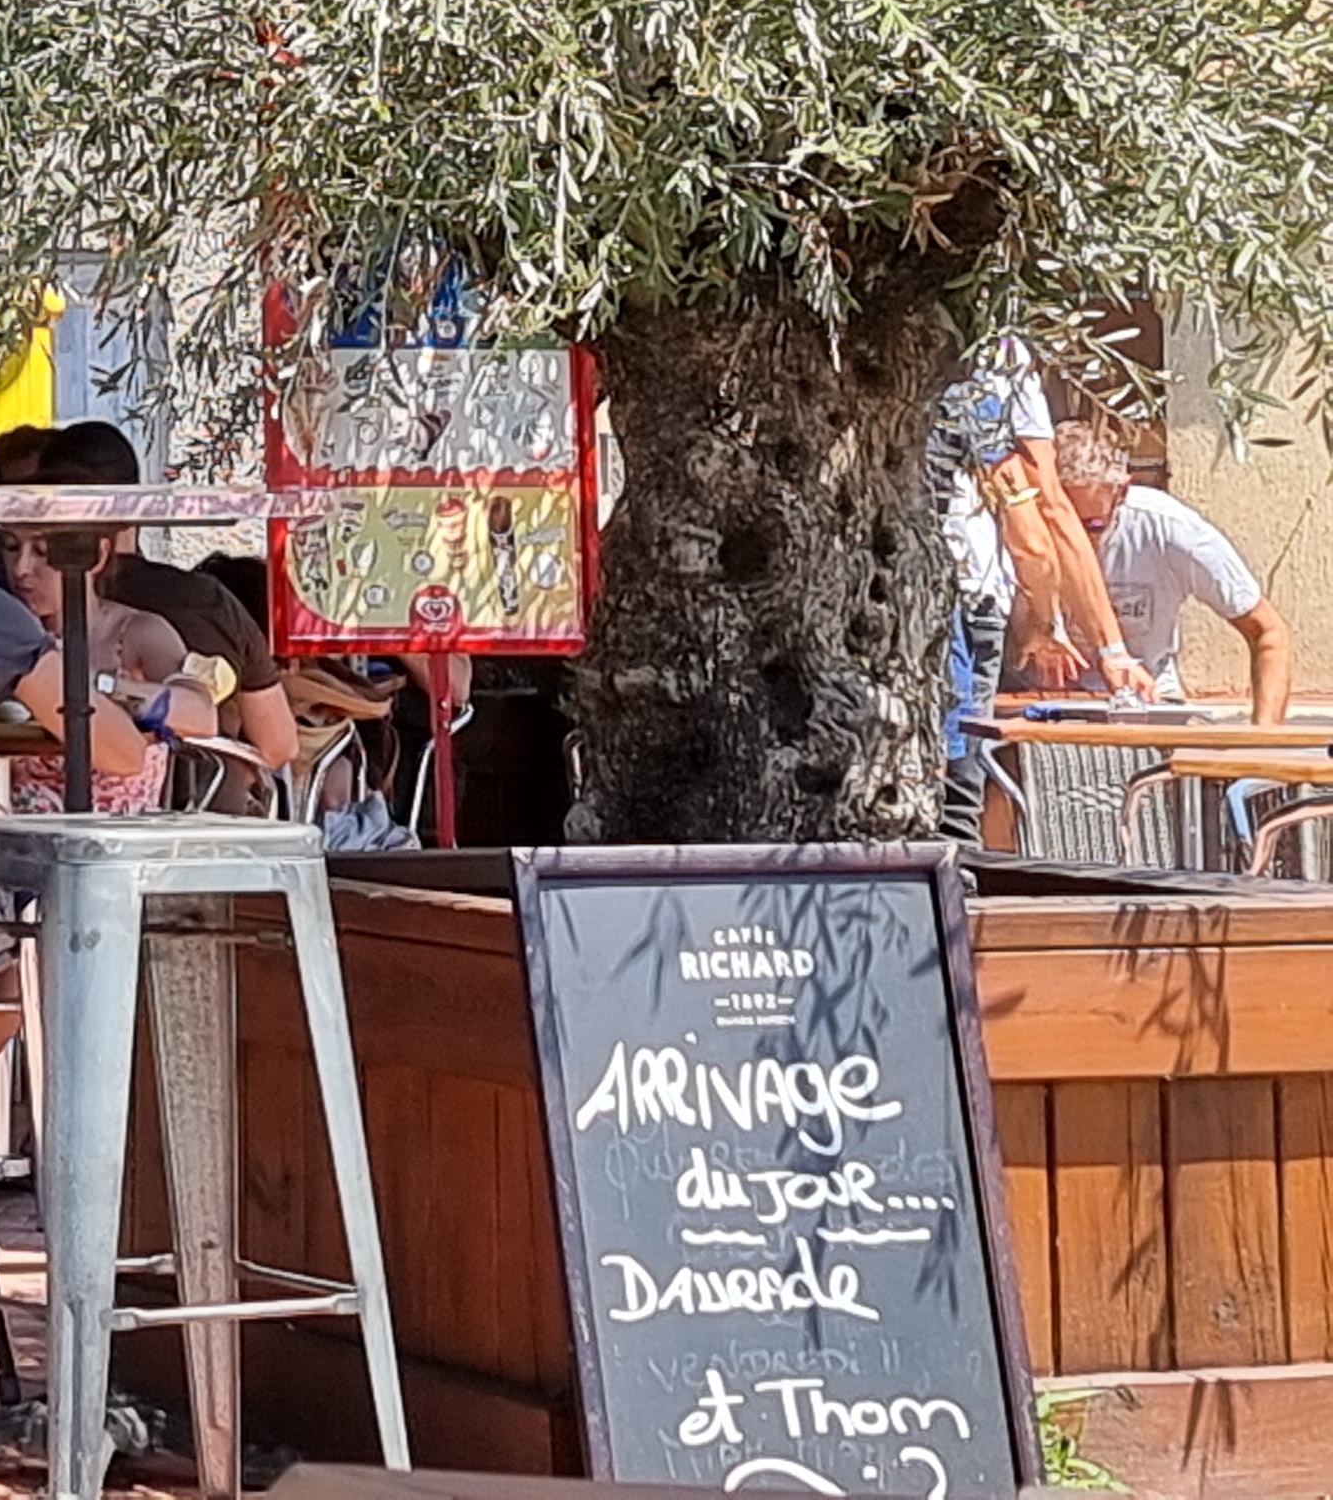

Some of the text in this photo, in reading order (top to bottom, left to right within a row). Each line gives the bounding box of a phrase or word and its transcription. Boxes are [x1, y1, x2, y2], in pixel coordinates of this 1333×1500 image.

[679, 949, 815, 981] RICHARD
[676, 1147, 752, 1212] du
[678, 1367, 745, 1446] et
